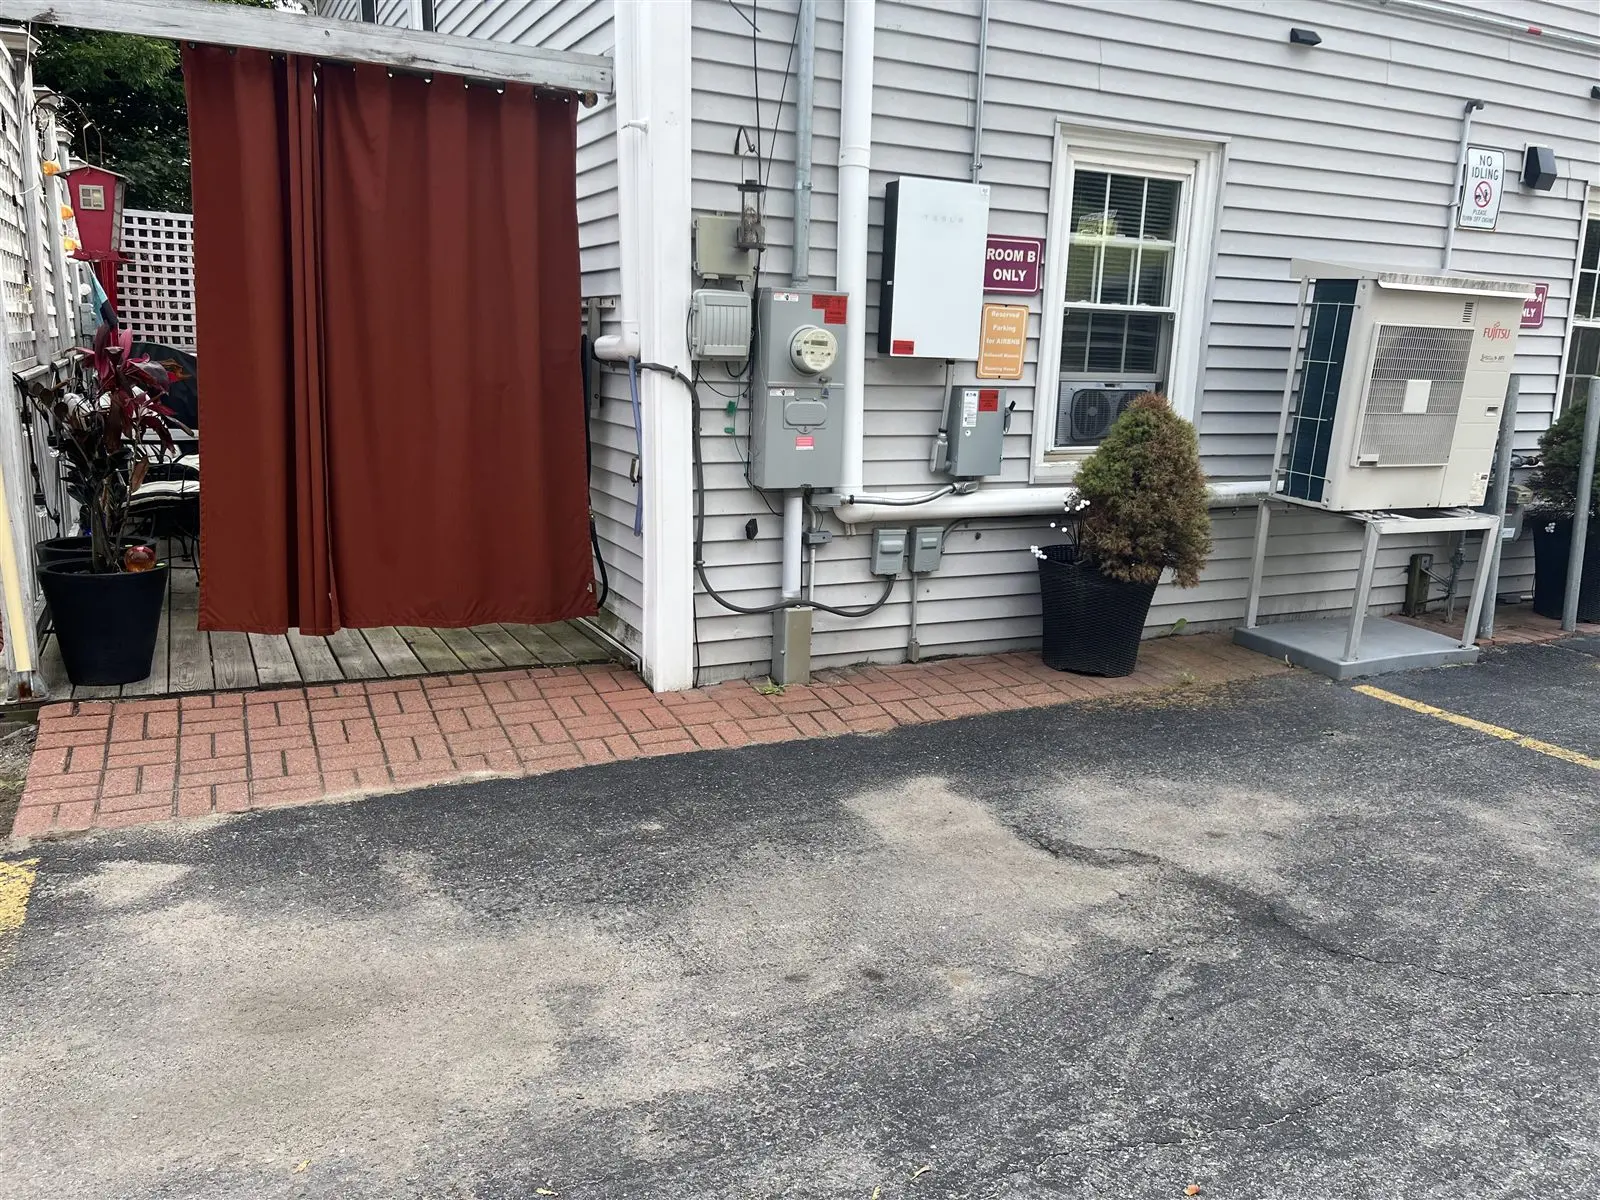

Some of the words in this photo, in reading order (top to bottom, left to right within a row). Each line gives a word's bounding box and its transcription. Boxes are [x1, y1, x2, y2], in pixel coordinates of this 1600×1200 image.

[1480, 154, 1493, 167] NO
[1471, 166, 1499, 181] IDLING
[986, 247, 1024, 262] ROOM
[1026, 250, 1036, 263] B
[992, 268, 1027, 282] ONLY
[991, 310, 1021, 319] Reserved
[1522, 307, 1537, 318] NLY
[992, 324, 1017, 334] Parking
[1483, 327, 1511, 341] FUJITSU
[986, 337, 995, 345] for
